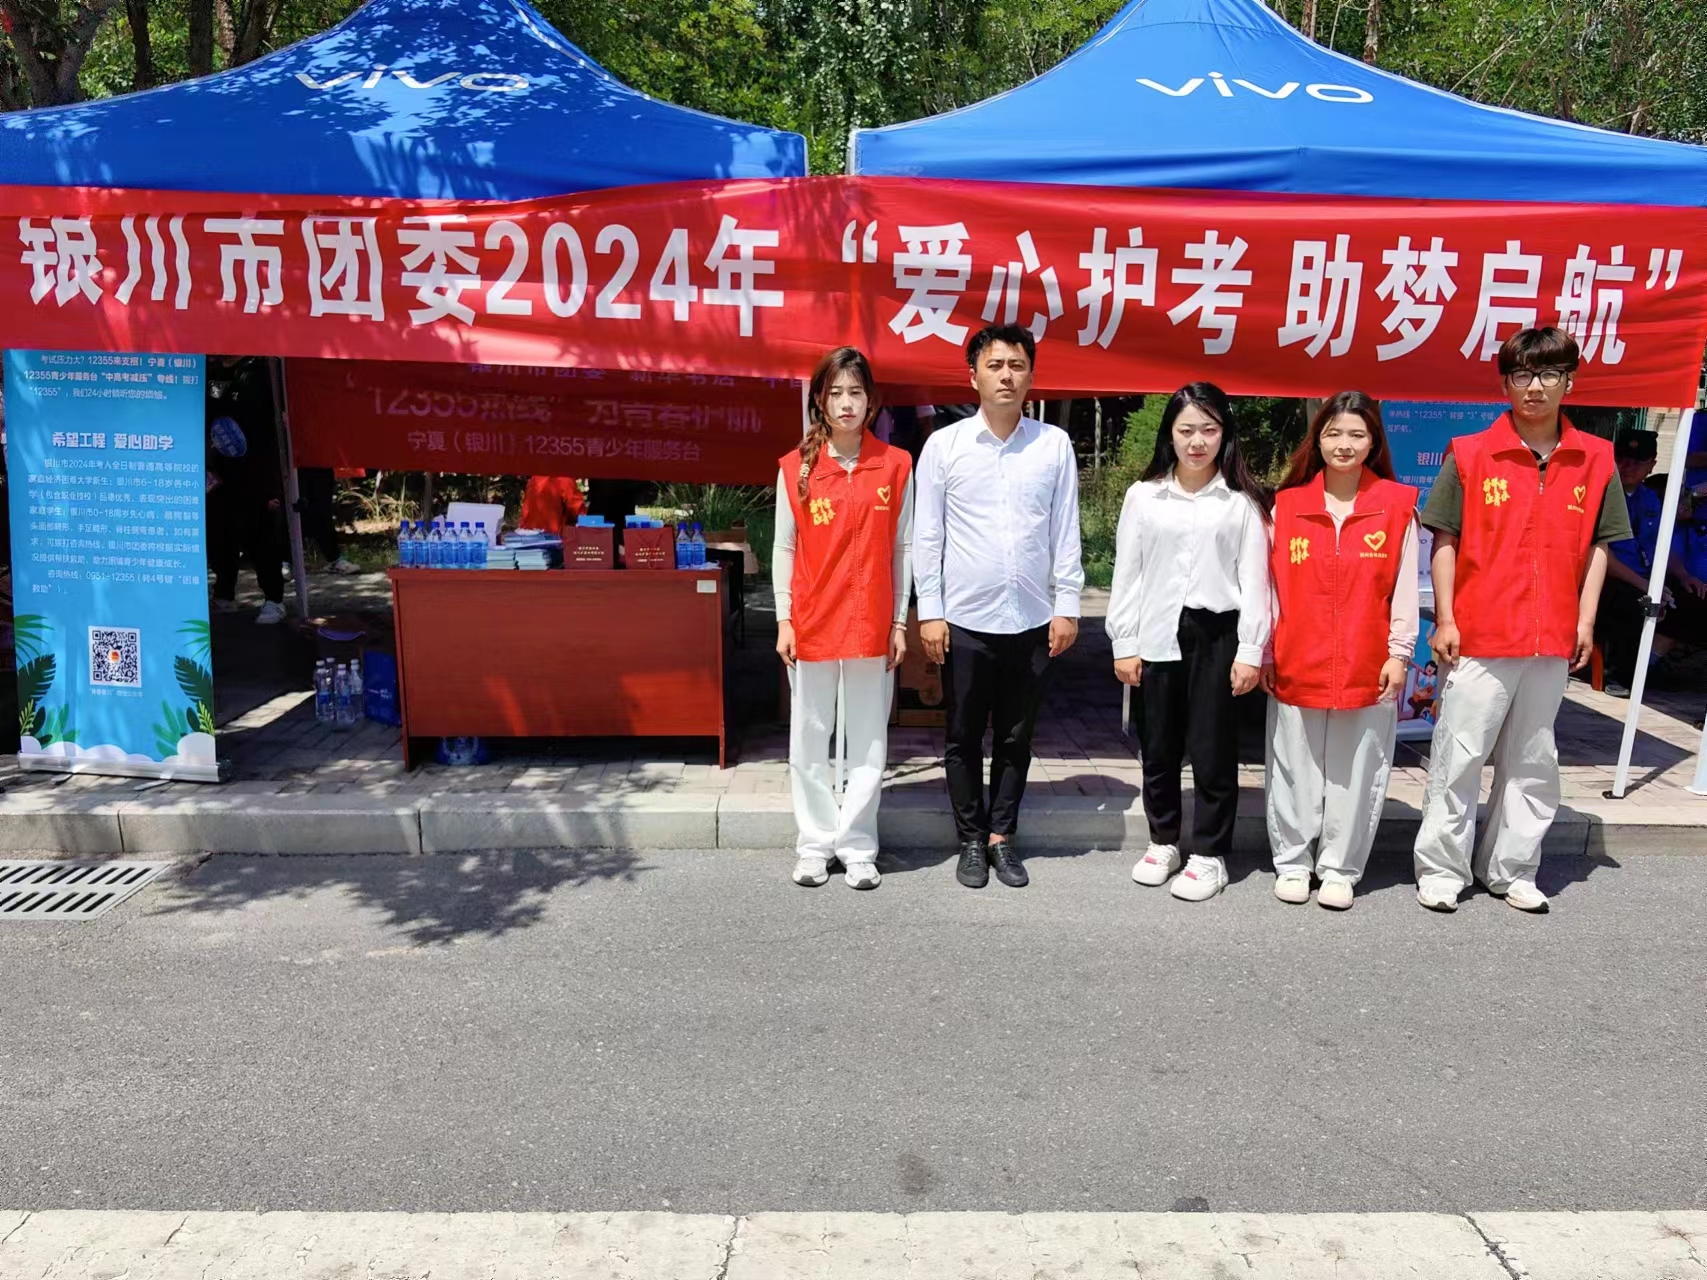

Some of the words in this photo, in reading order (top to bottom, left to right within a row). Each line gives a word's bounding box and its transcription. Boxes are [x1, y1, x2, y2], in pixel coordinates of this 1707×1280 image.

[294, 64, 529, 92] vivo
[1136, 71, 1374, 103] vivo
[19, 213, 784, 337] 银川市团委2024年
[52, 432, 106, 449] 希望工程
[113, 433, 174, 451] 爱心助学
